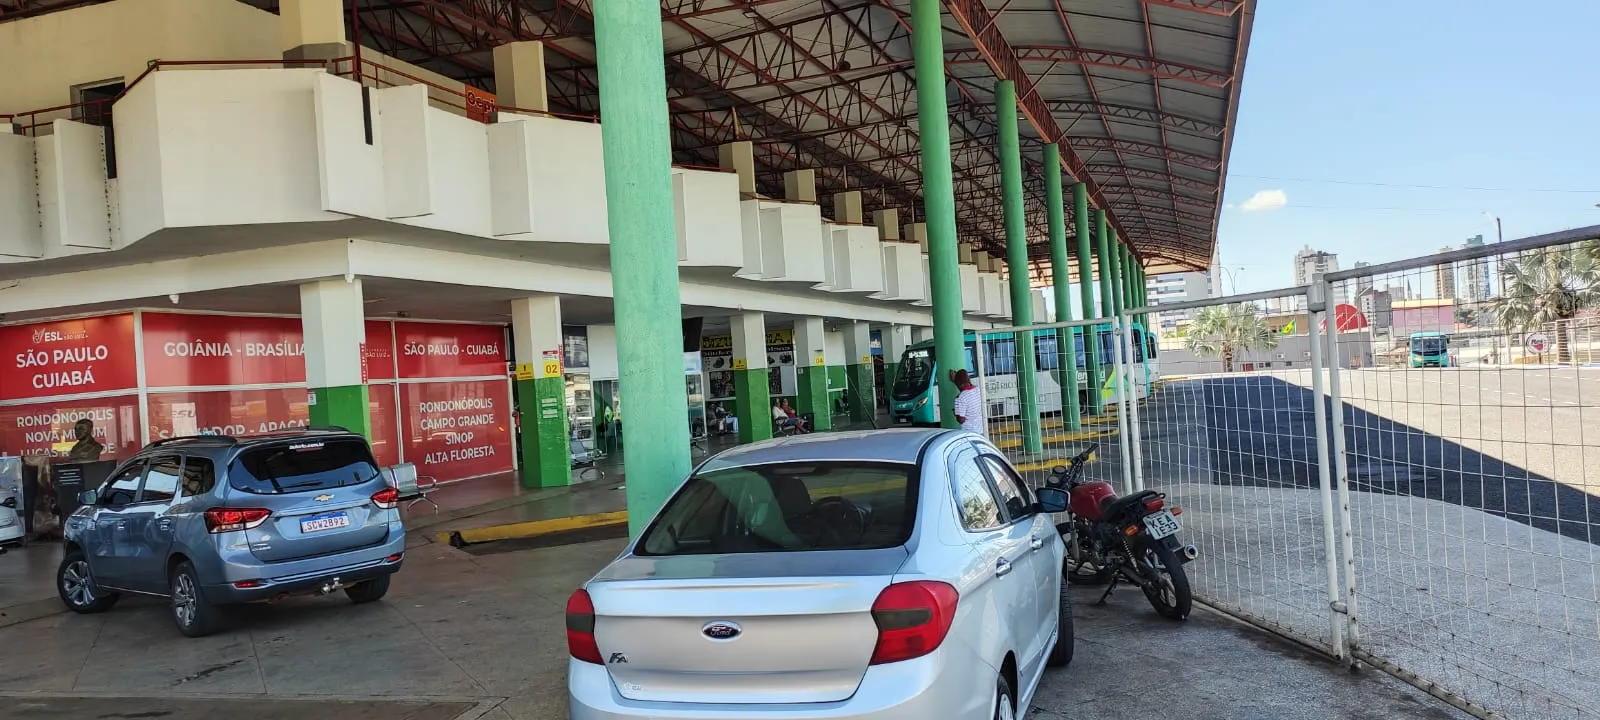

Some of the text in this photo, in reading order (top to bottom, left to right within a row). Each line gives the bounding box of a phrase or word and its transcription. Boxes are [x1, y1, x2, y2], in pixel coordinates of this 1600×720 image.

[44, 331, 64, 342] ESL
[164, 339, 233, 357] GOIÂNIA
[404, 342, 425, 356] SÃO
[427, 344, 459, 356] PAULO
[466, 342, 499, 356] CUIABÁ
[16, 345, 108, 369] SÃO PAULO
[32, 365, 95, 389] CUIABÁ
[545, 364, 558, 374] 02
[419, 397, 493, 414] RONDONÓPOLIS
[16, 408, 114, 428] RONDONÓPOLIS
[420, 414, 495, 430] CAMPO GRANDE
[25, 430, 60, 443] NOVA
[445, 431, 474, 445] SINOP
[424, 446, 495, 465] ALTA FLORESTA
[1149, 514, 1173, 529] KEA
